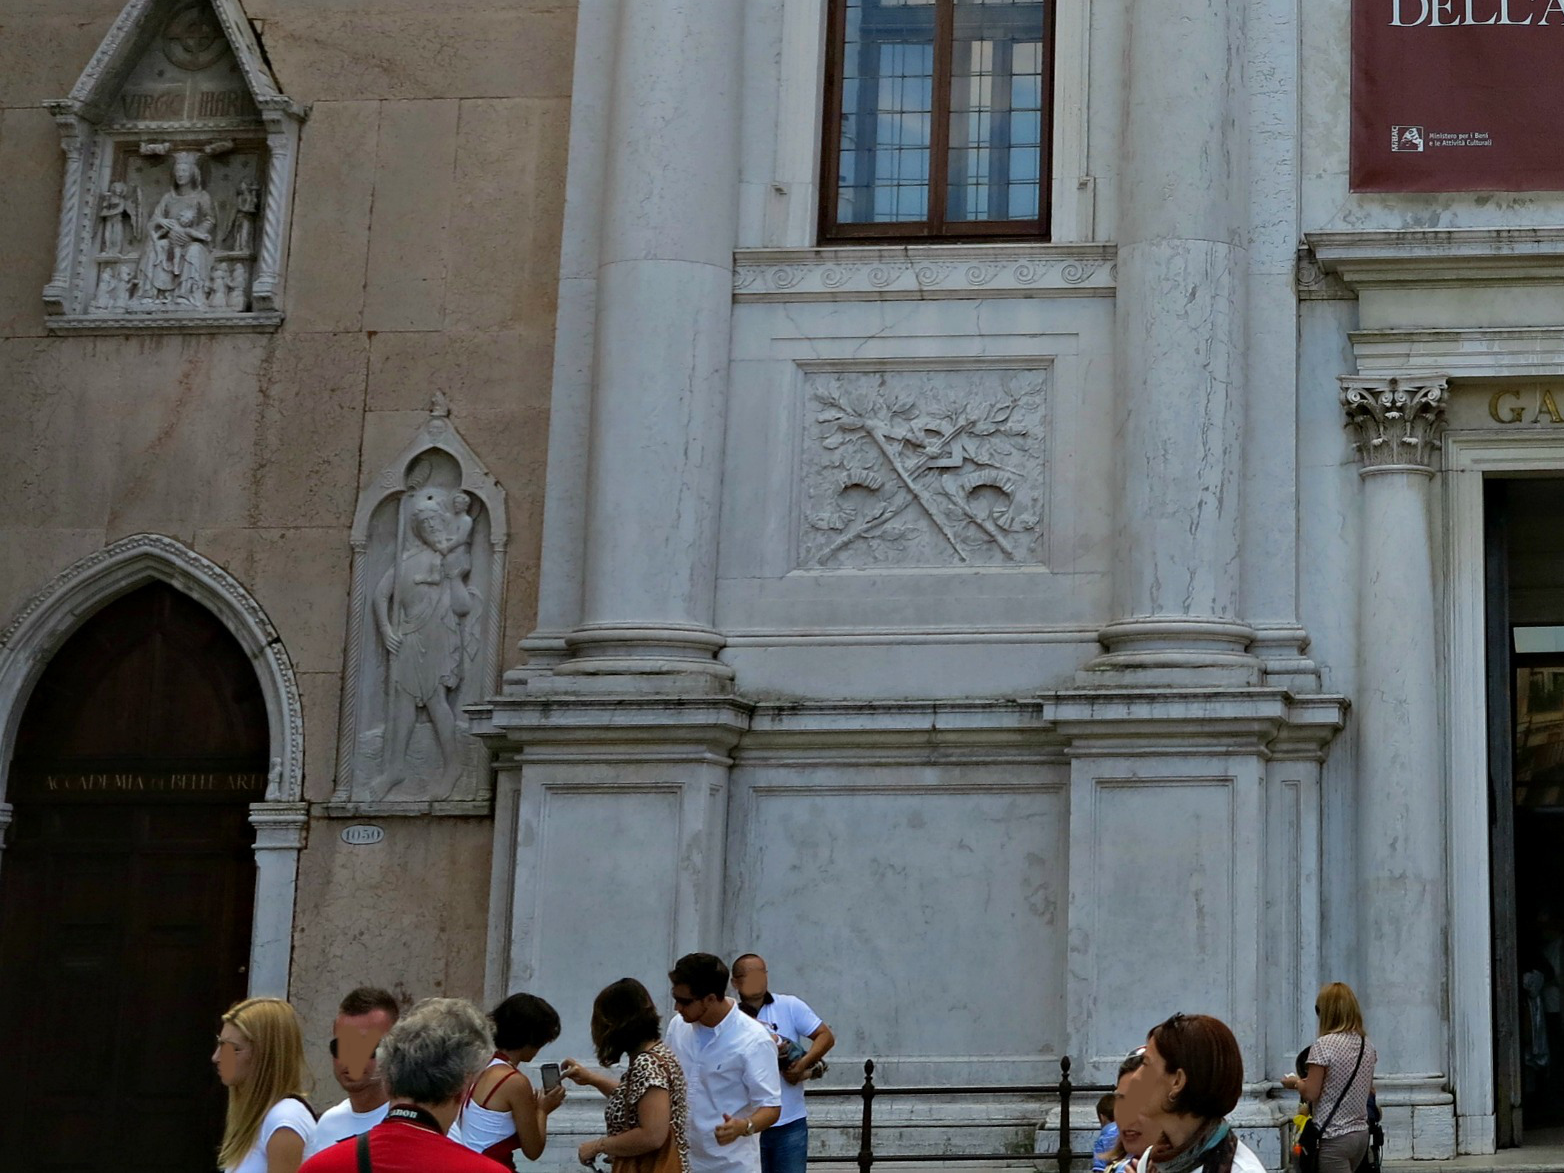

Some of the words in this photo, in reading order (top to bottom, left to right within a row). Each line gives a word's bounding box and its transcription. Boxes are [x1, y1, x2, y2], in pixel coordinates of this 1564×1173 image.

[44, 774, 144, 790] ACCADEMIA
[346, 828, 381, 841] 1050
[387, 1108, 418, 1119] anon
